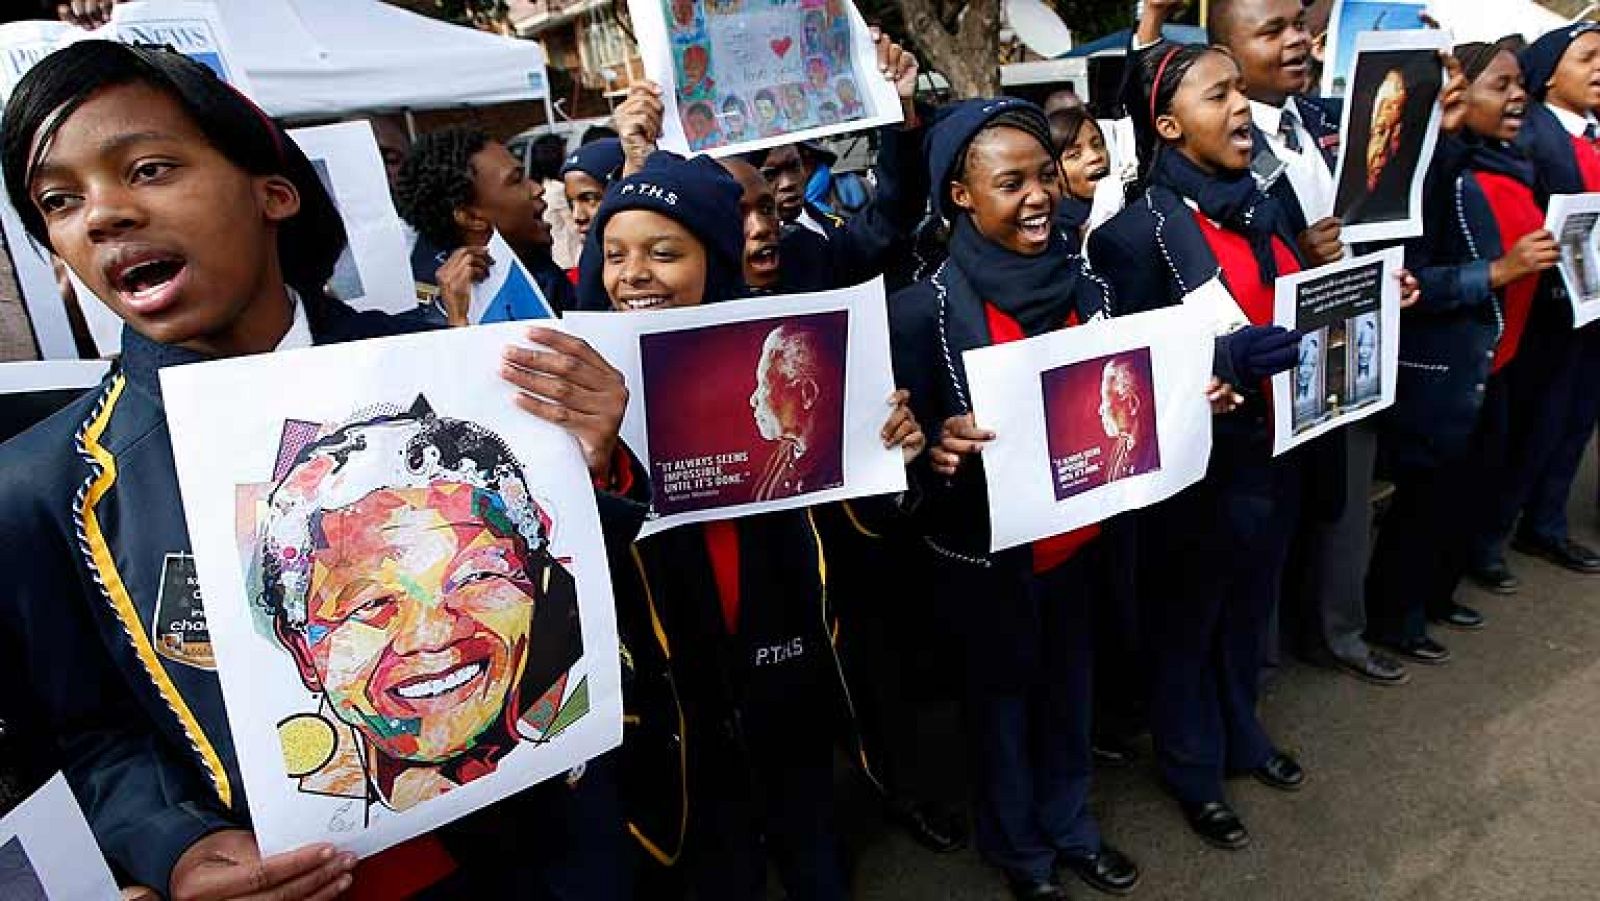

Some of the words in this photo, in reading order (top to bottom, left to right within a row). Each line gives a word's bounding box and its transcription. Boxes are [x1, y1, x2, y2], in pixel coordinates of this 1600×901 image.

[674, 457, 714, 470] ALWAYS
[716, 452, 749, 464] SEEMS
[663, 467, 723, 482] IMPOSSIBLE
[664, 481, 692, 494] UNTIL
